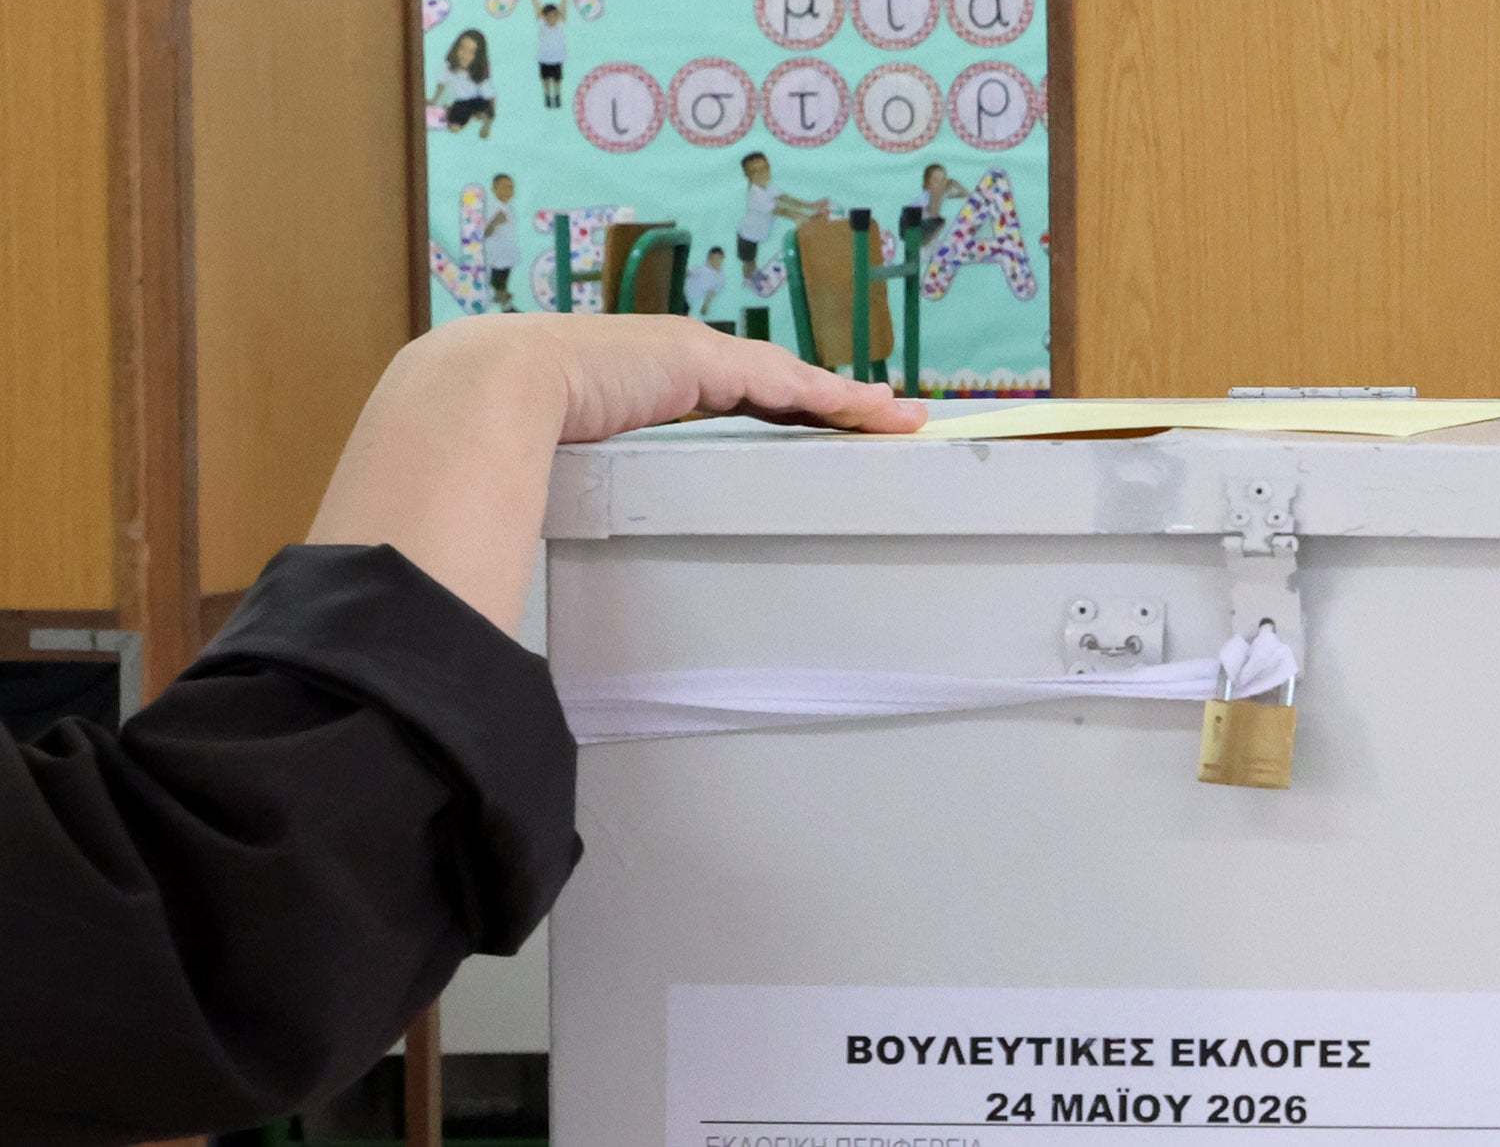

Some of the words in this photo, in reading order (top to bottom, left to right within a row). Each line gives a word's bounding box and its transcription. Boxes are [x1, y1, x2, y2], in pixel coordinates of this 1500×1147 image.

[846, 1035, 1154, 1067] ΒΟΥΛΕΥΤΙΚΕΣ
[1171, 1038, 1371, 1069] ΕΚΛΟΓΕΣ
[985, 1092, 1035, 1122] 24
[1051, 1087, 1192, 1124] ΜΑΪΟΥ
[1206, 1094, 1308, 1124] 2026
